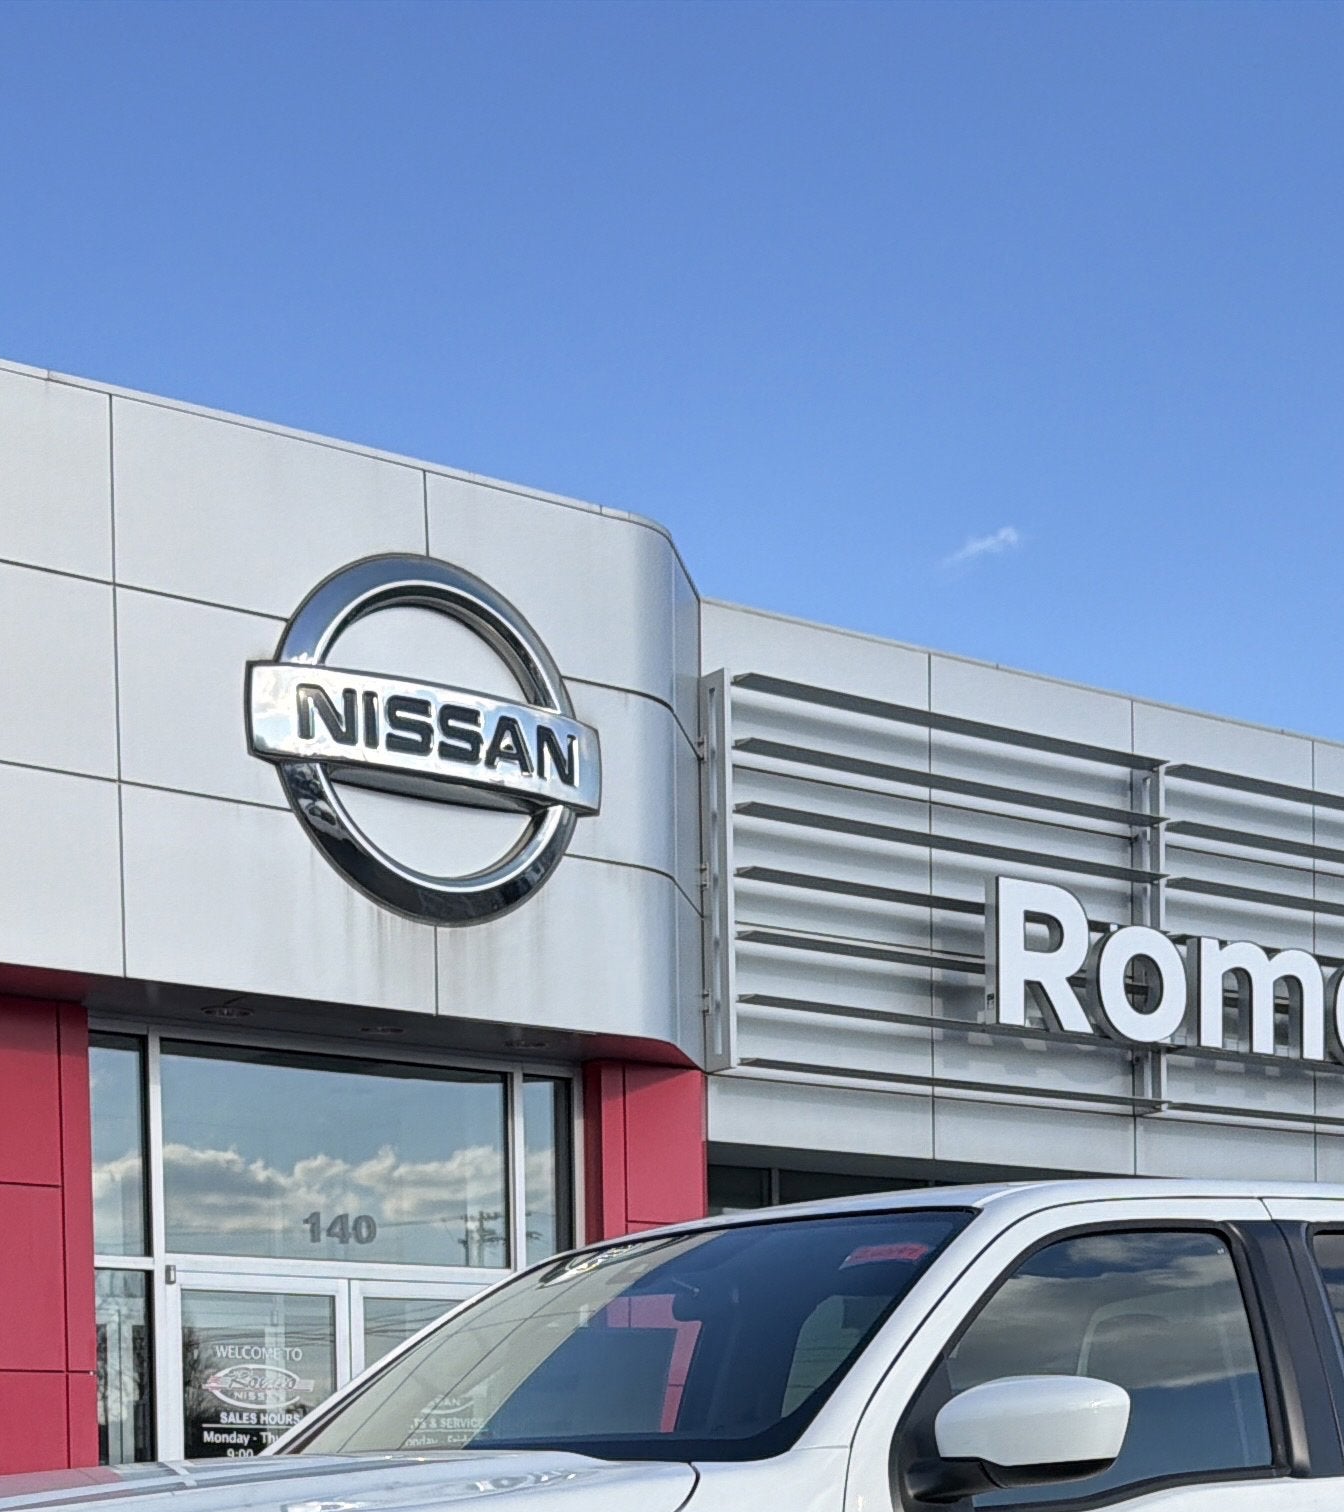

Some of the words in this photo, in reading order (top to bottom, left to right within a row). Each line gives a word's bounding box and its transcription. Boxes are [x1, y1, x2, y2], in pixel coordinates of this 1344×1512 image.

[296, 683, 579, 787] NISSAN
[302, 1211, 377, 1245] 140
[215, 1344, 281, 1360] WELCOME
[282, 1347, 303, 1362] TO
[219, 1411, 257, 1425] SALES
[259, 1412, 301, 1425] HOURS
[202, 1430, 251, 1447] Monday
